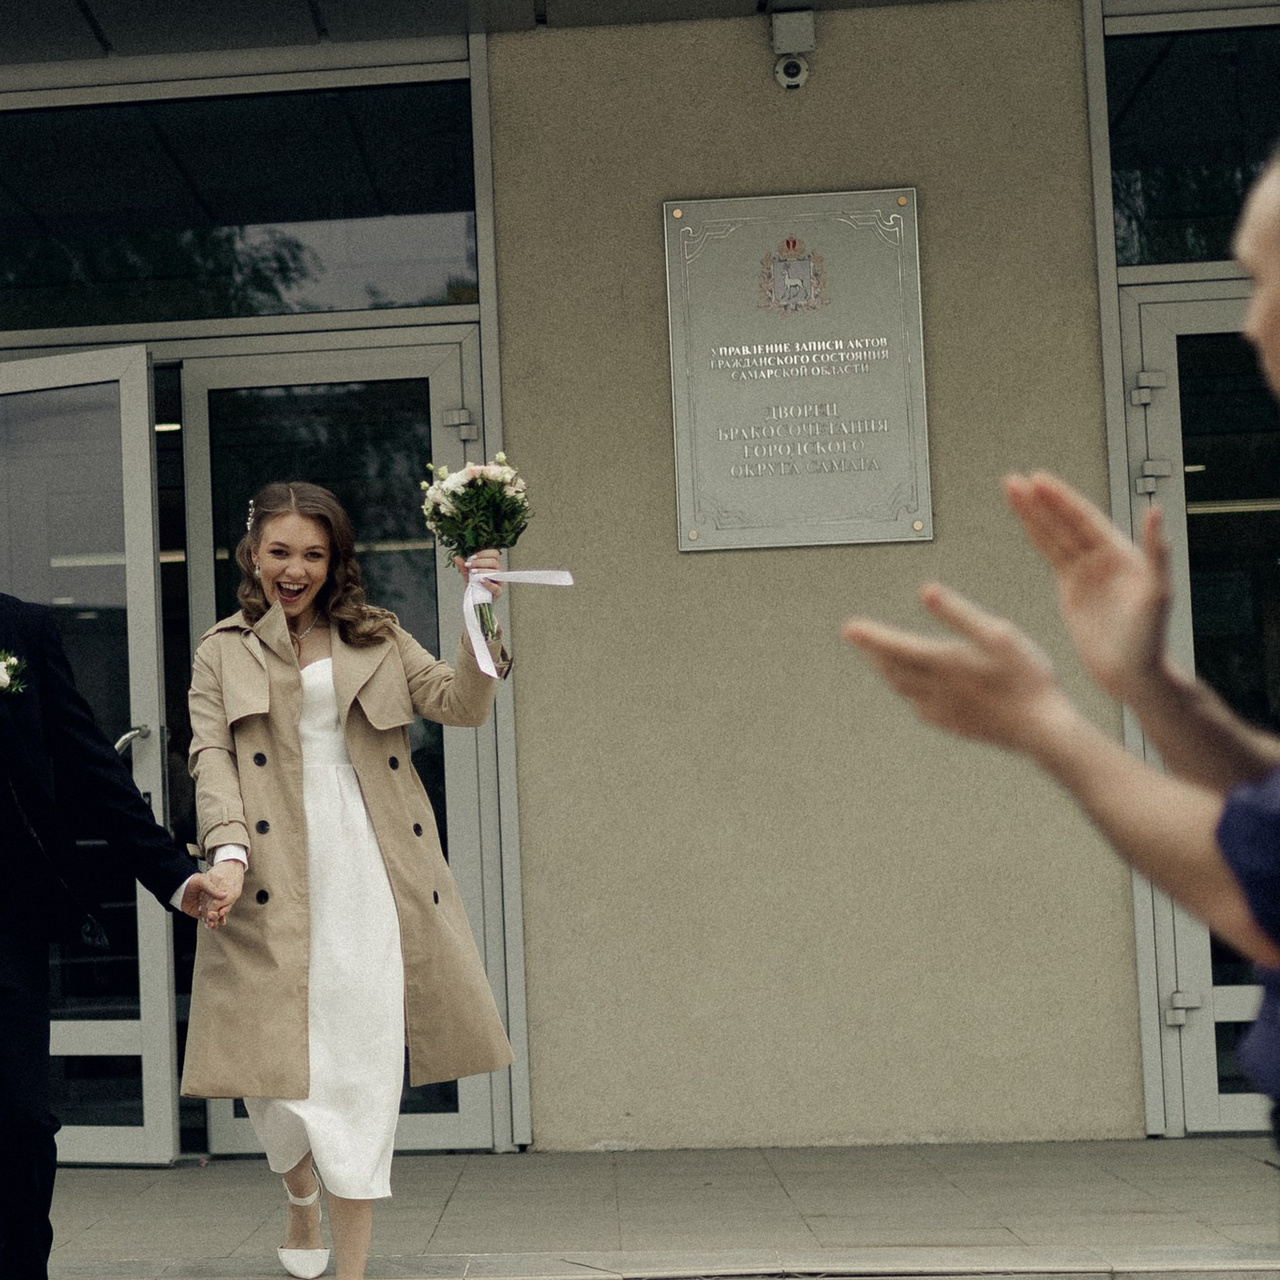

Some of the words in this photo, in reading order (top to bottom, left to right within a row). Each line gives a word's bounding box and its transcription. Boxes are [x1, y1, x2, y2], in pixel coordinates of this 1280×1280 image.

[710, 342, 791, 357] УПРАВЛЕНИЕ
[795, 339, 844, 353] ЗАПИСИ
[846, 337, 888, 350] АКТОВ
[710, 353, 810, 370] ГРАЖДАНСКОГО
[812, 350, 889, 365] СОСТОЯНИЯ
[731, 364, 808, 381] САМАРСКОЙ
[811, 363, 870, 377] ОБЛАСТИ
[765, 403, 839, 423] ДВОРЕЦ
[717, 419, 889, 442] БРАКОСОЧЕТАНИЯ
[743, 439, 865, 459] ГОРОДСКОГО
[730, 461, 801, 478] ОКРУГА
[806, 458, 881, 475] САМАРА
